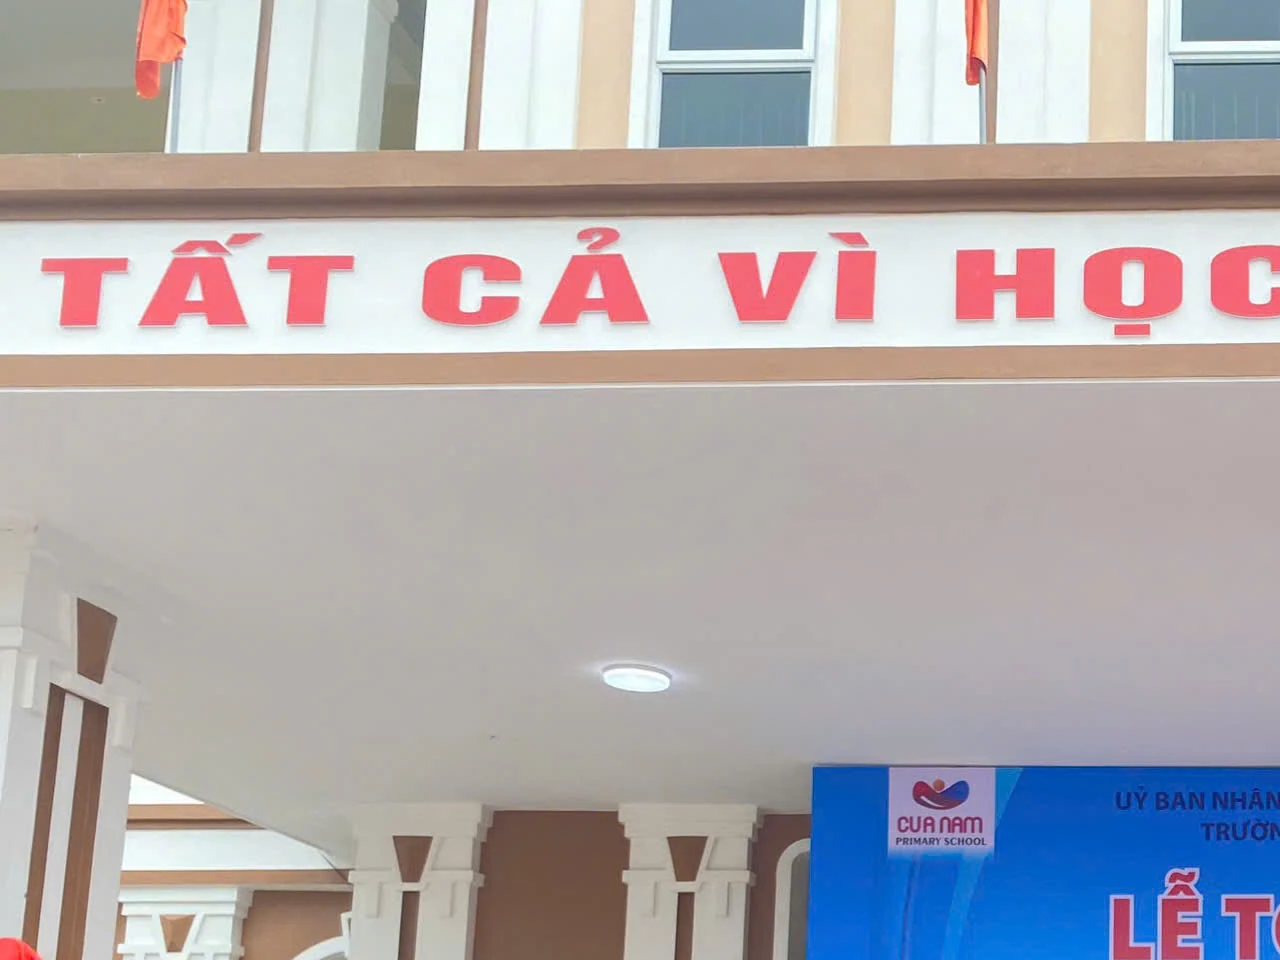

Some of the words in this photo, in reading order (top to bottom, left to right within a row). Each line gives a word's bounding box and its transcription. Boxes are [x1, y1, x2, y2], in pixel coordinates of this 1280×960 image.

[43, 231, 354, 327] TẤT
[421, 227, 649, 326] CẢ
[718, 231, 877, 322] VÌ
[1155, 791, 1205, 810] BAN
[895, 837, 941, 846] PRIMARY
[944, 837, 988, 846] SCHOOL
